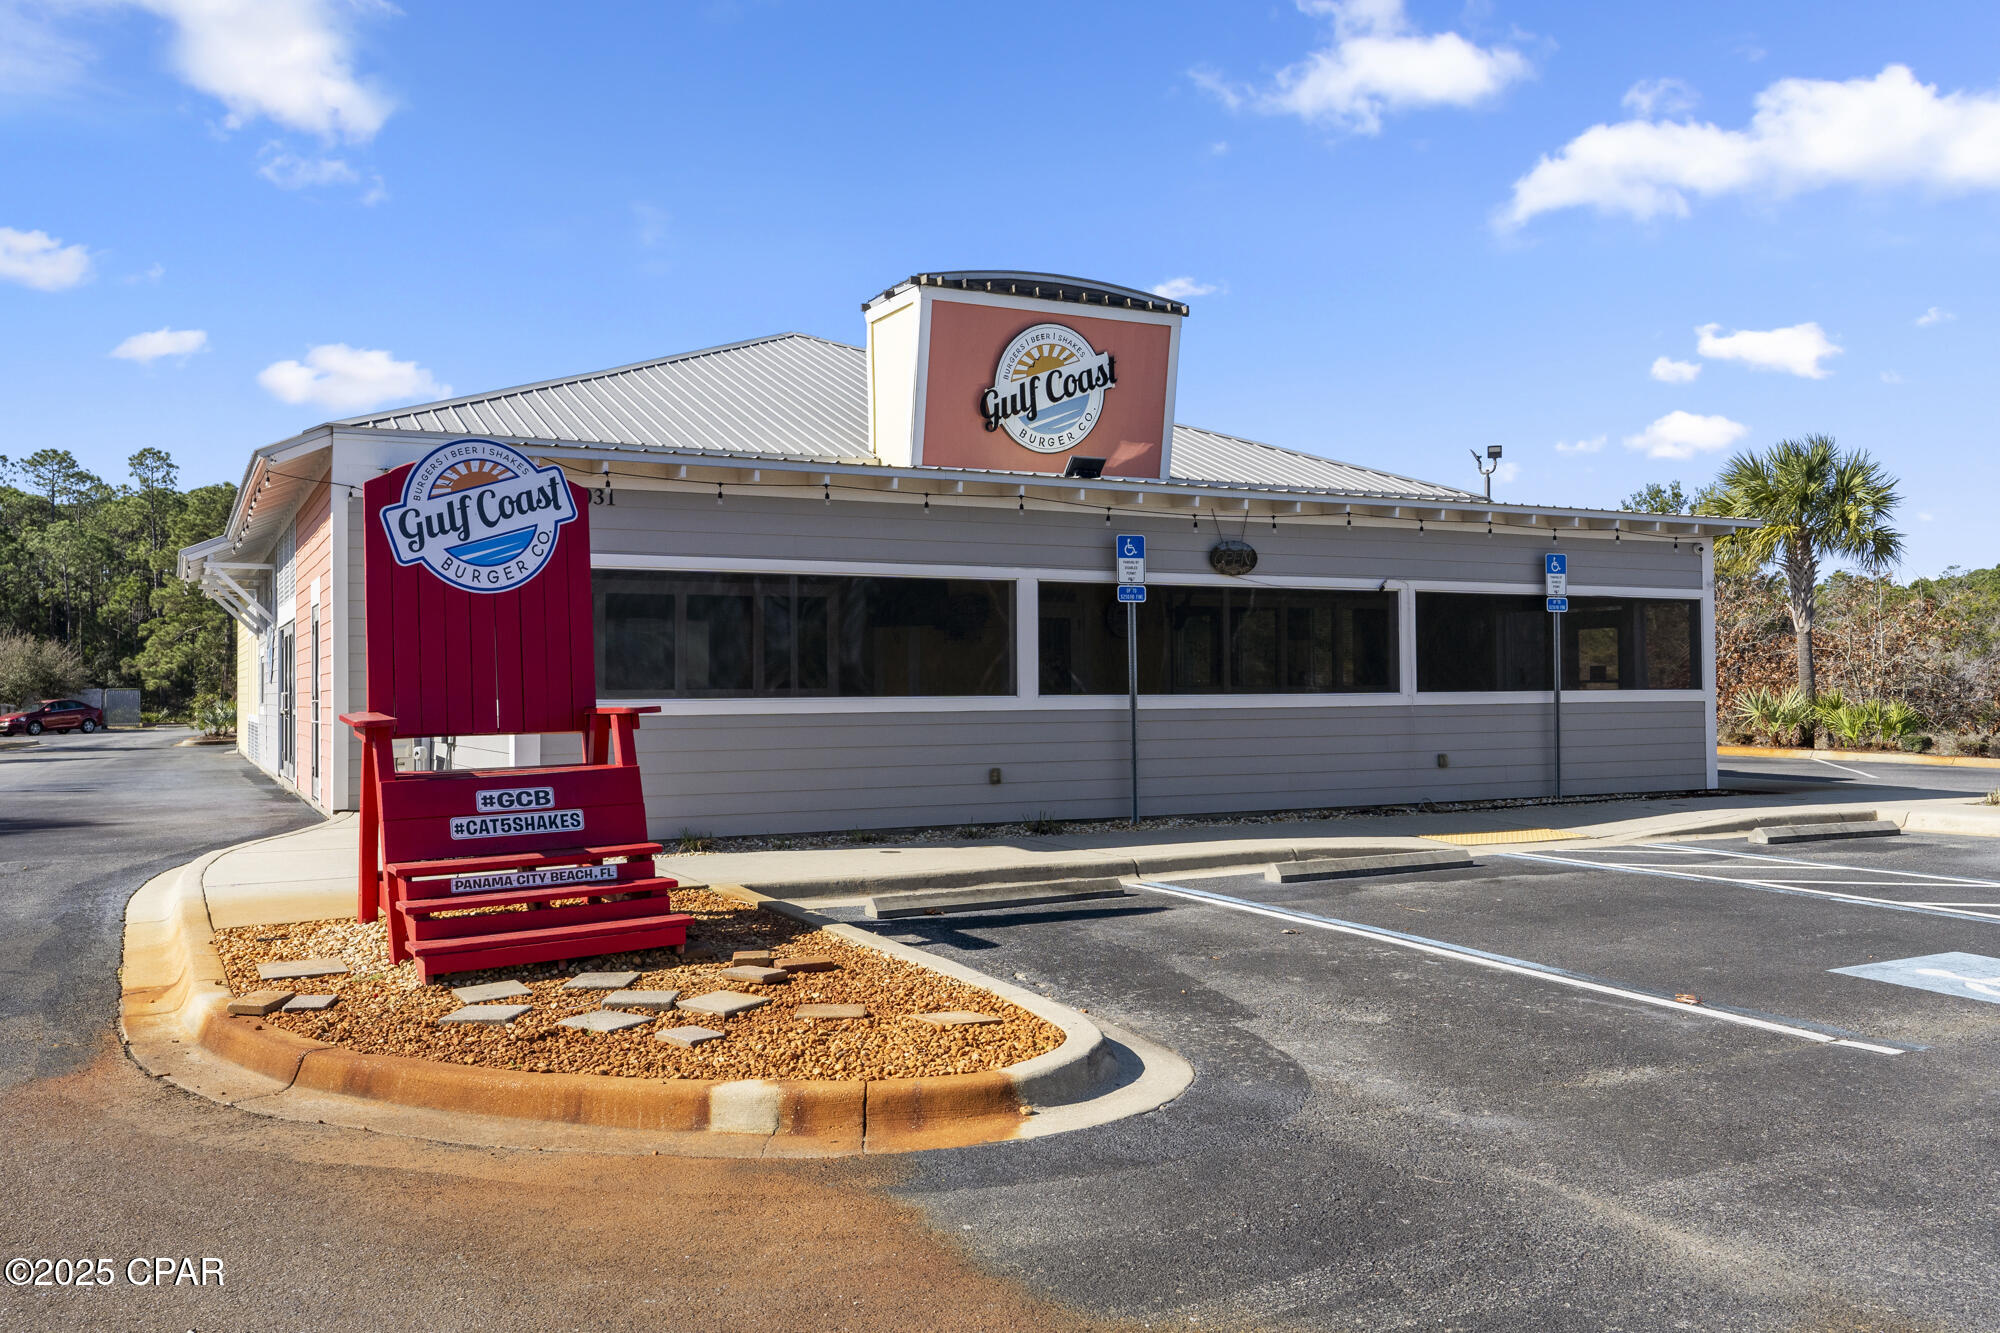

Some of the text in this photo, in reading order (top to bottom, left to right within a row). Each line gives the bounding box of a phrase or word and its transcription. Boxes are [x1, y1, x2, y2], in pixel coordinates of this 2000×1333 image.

[1003, 333, 1086, 380] BURGERS BEER SHAKES
[980, 355, 1118, 432] Gulf Coast
[1019, 428, 1076, 447] BURGER
[413, 446, 530, 501] BURGERS BEER SHAKES
[398, 476, 562, 552] Gulf Coast
[441, 530, 552, 584] BURGER CO.
[480, 789, 551, 809] #GCB
[454, 812, 582, 836] #CAT5SHAKES
[454, 876, 513, 891] PANAMA
[516, 872, 547, 886] CITY
[600, 867, 615, 878] FL
